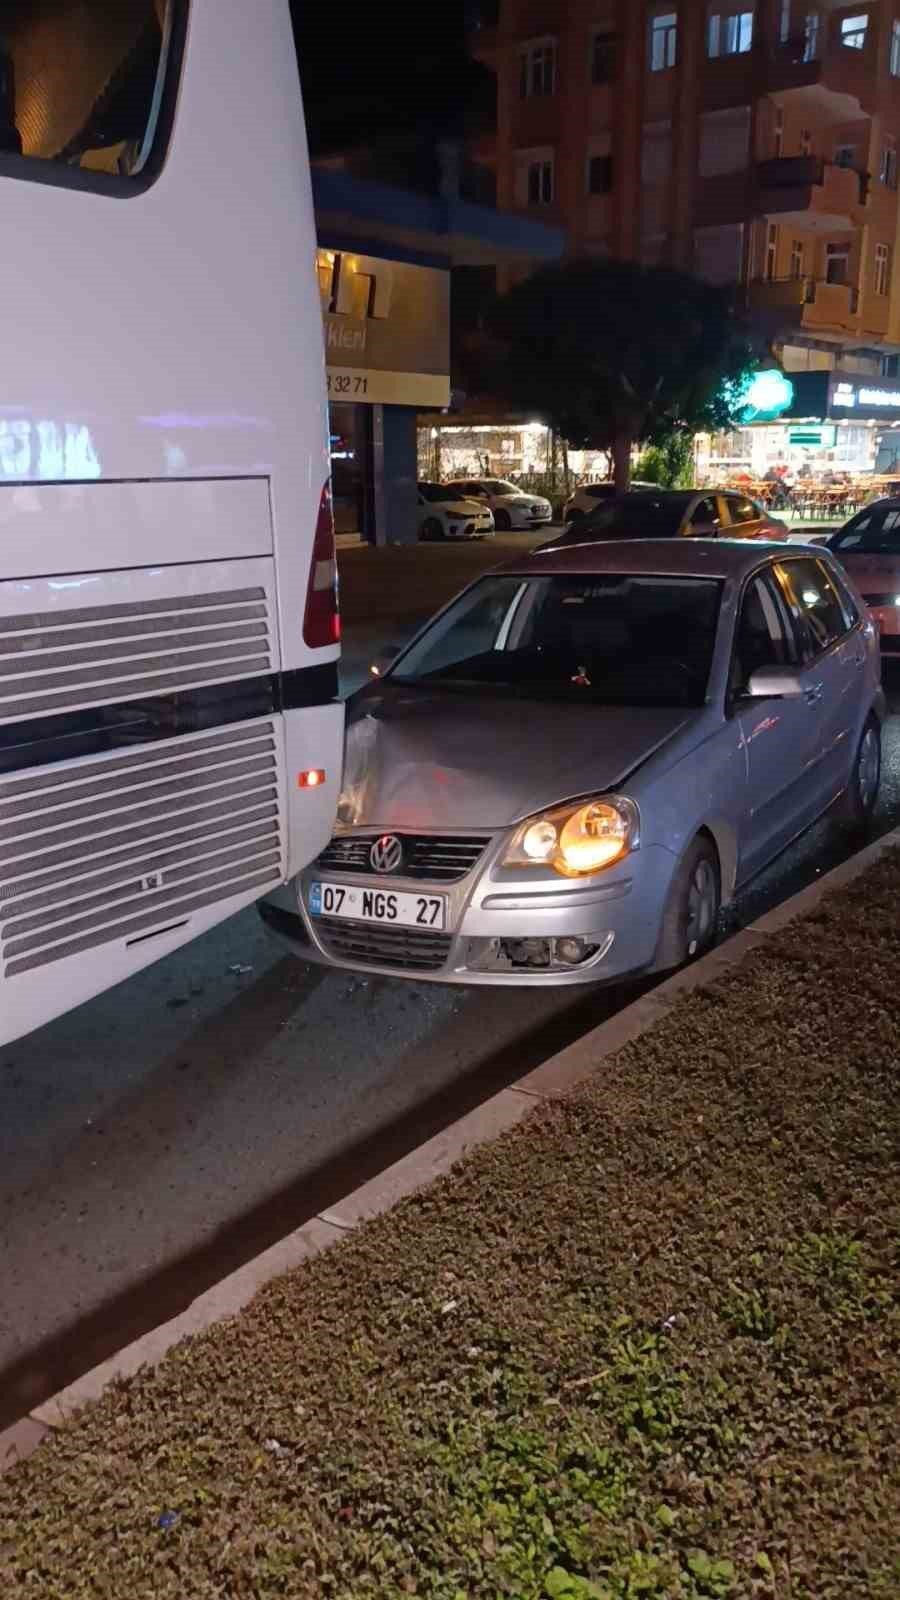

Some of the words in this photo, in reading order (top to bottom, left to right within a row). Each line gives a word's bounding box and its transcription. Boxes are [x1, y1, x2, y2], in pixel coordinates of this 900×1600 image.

[334, 375, 351, 393] 32
[353, 377, 368, 393] 71
[323, 887, 346, 913] 07
[362, 891, 398, 919] NGS
[416, 898, 441, 925] 27
